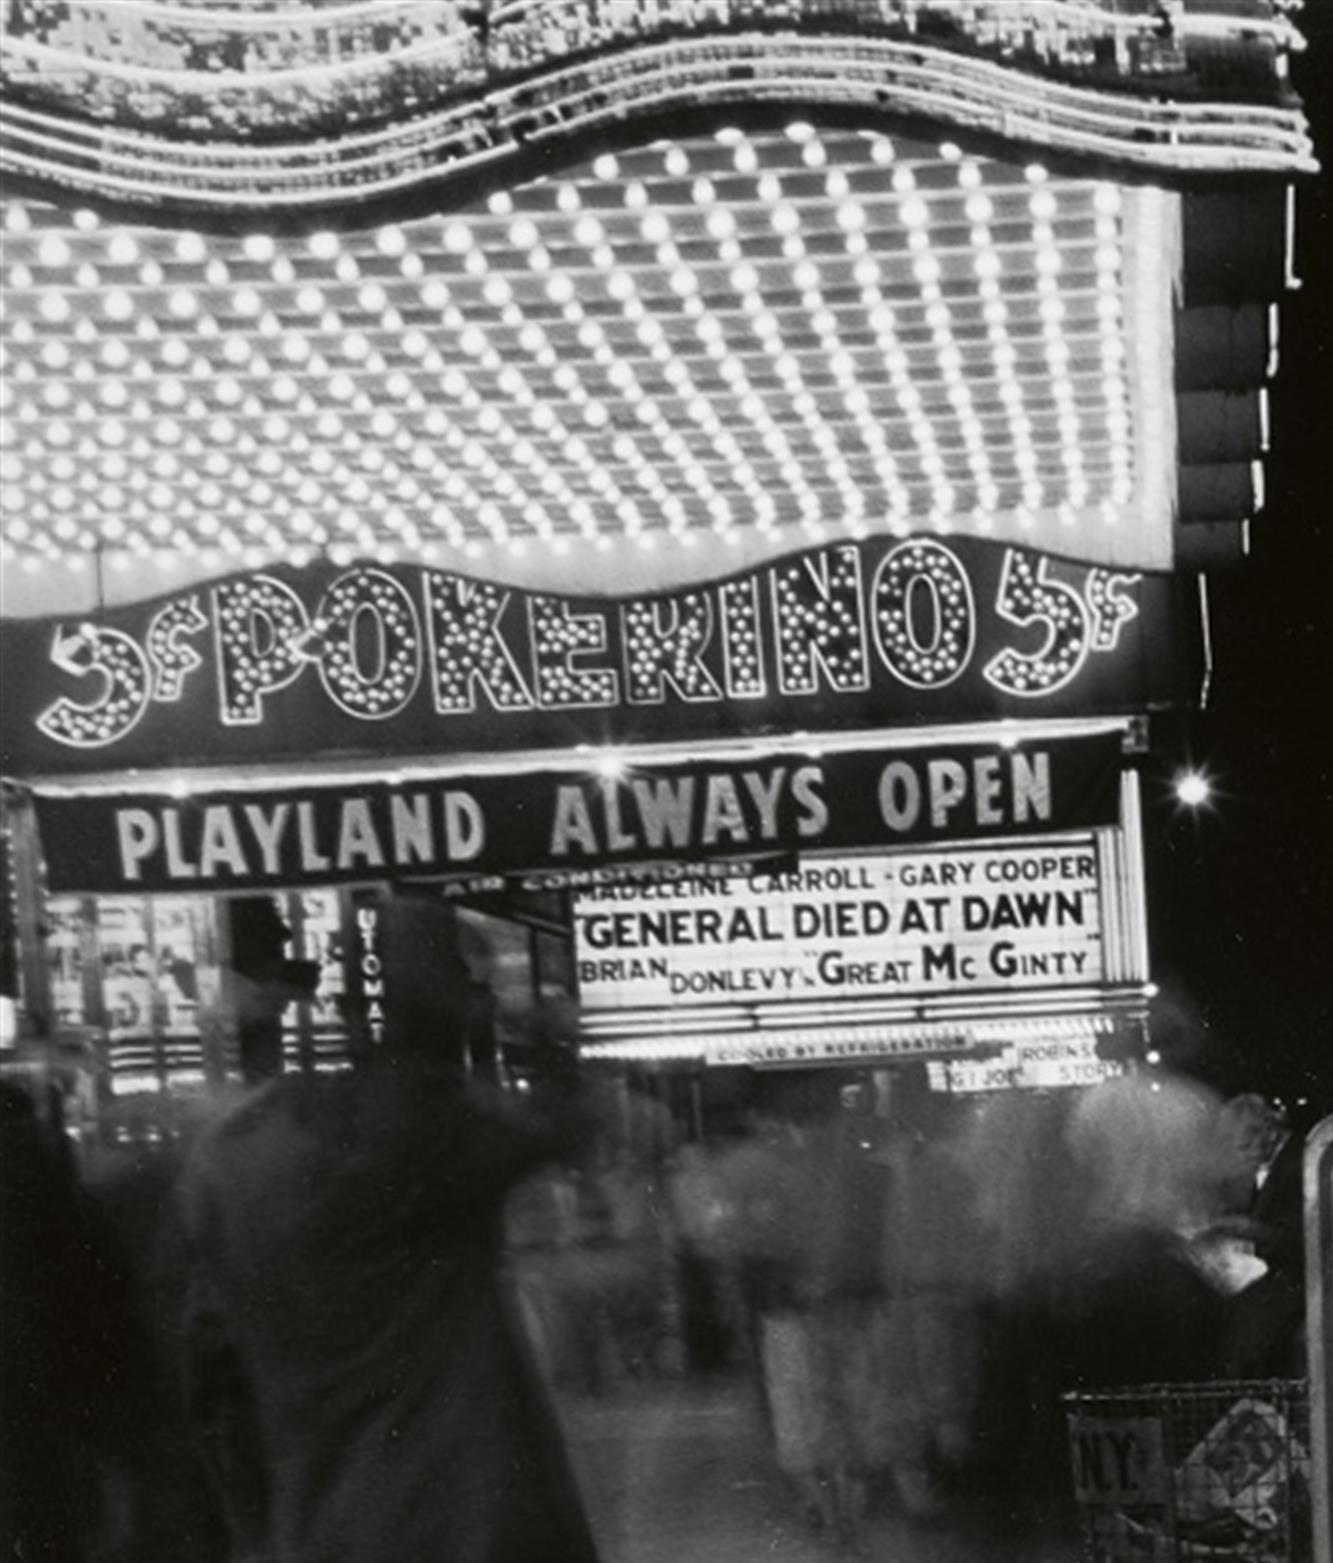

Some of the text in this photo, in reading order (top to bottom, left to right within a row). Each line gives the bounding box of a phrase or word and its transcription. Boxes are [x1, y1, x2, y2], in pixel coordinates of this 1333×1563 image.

[210, 537, 976, 725] POKERINO
[116, 752, 1052, 880] PLAYLAND ALWAYS OPEN
[749, 866, 875, 894] CARROLL
[899, 861, 976, 887] GARY
[984, 855, 1095, 883] COOPER
[793, 900, 891, 938] DIED
[901, 897, 950, 934] AT
[578, 957, 669, 985] BRIAN
[670, 967, 795, 994] DONLEVY
